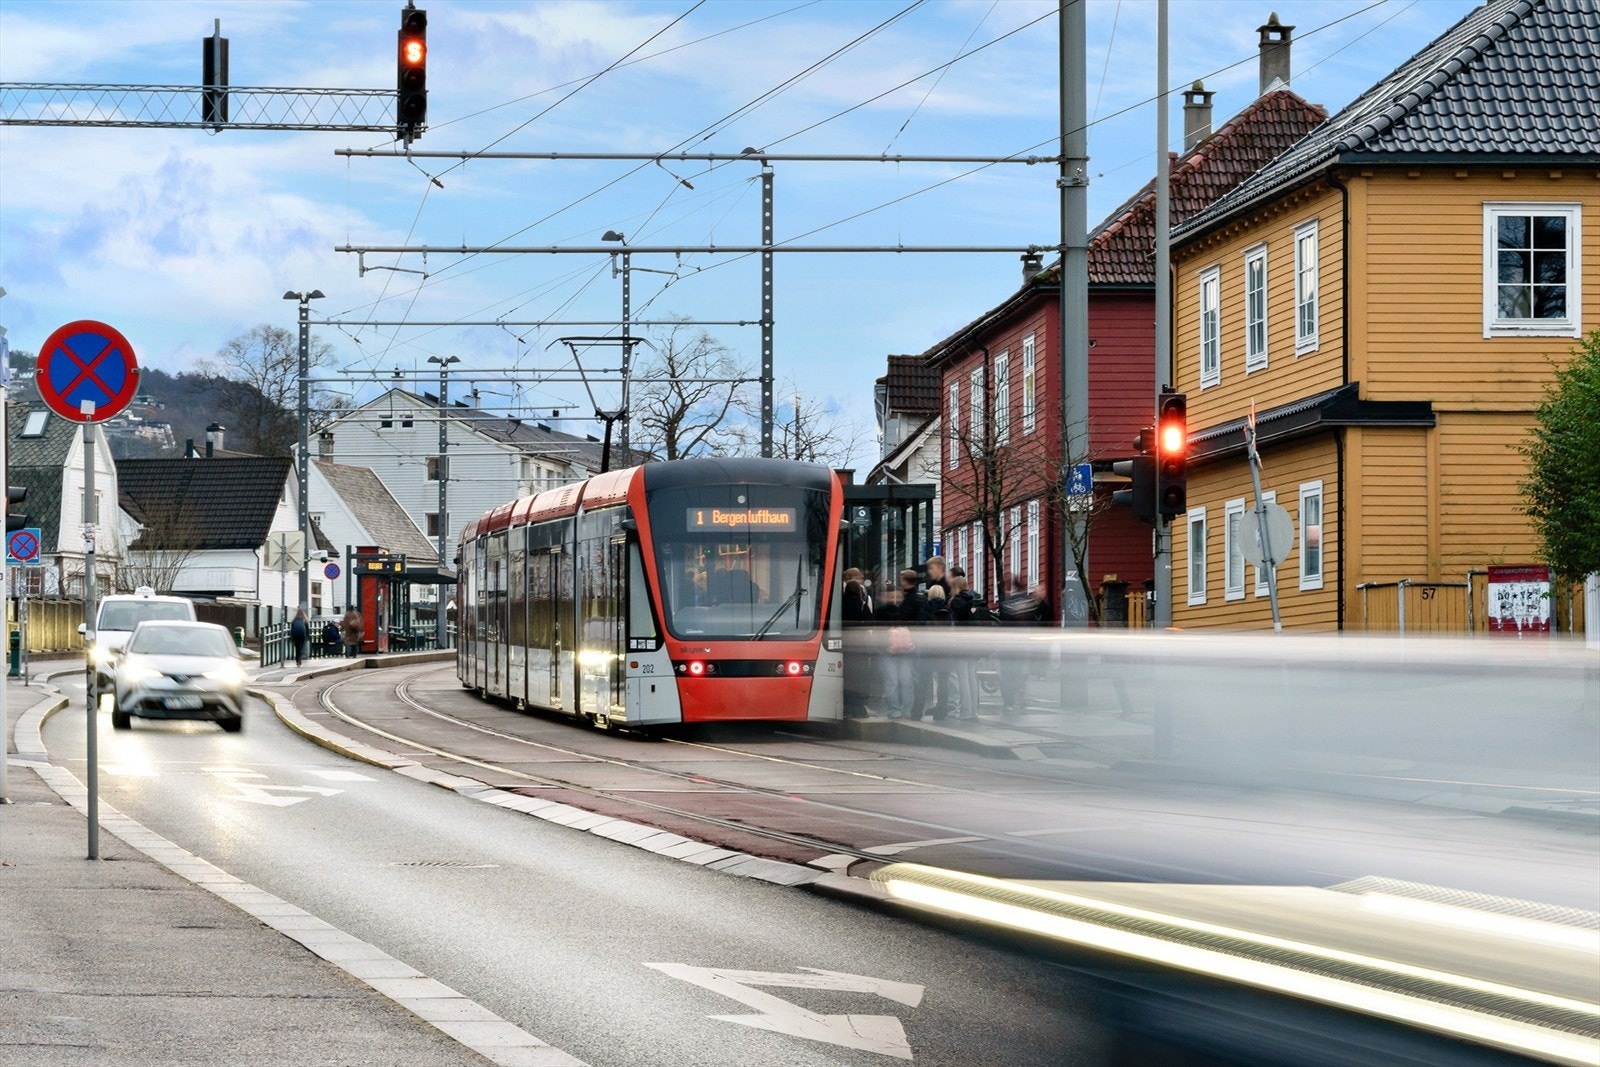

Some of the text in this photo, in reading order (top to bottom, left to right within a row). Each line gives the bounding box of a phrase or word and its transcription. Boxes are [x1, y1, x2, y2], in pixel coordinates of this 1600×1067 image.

[697, 510, 789, 527] 1 Bergen lufthavn
[1422, 587, 1436, 600] 57
[642, 664, 655, 674] 202
